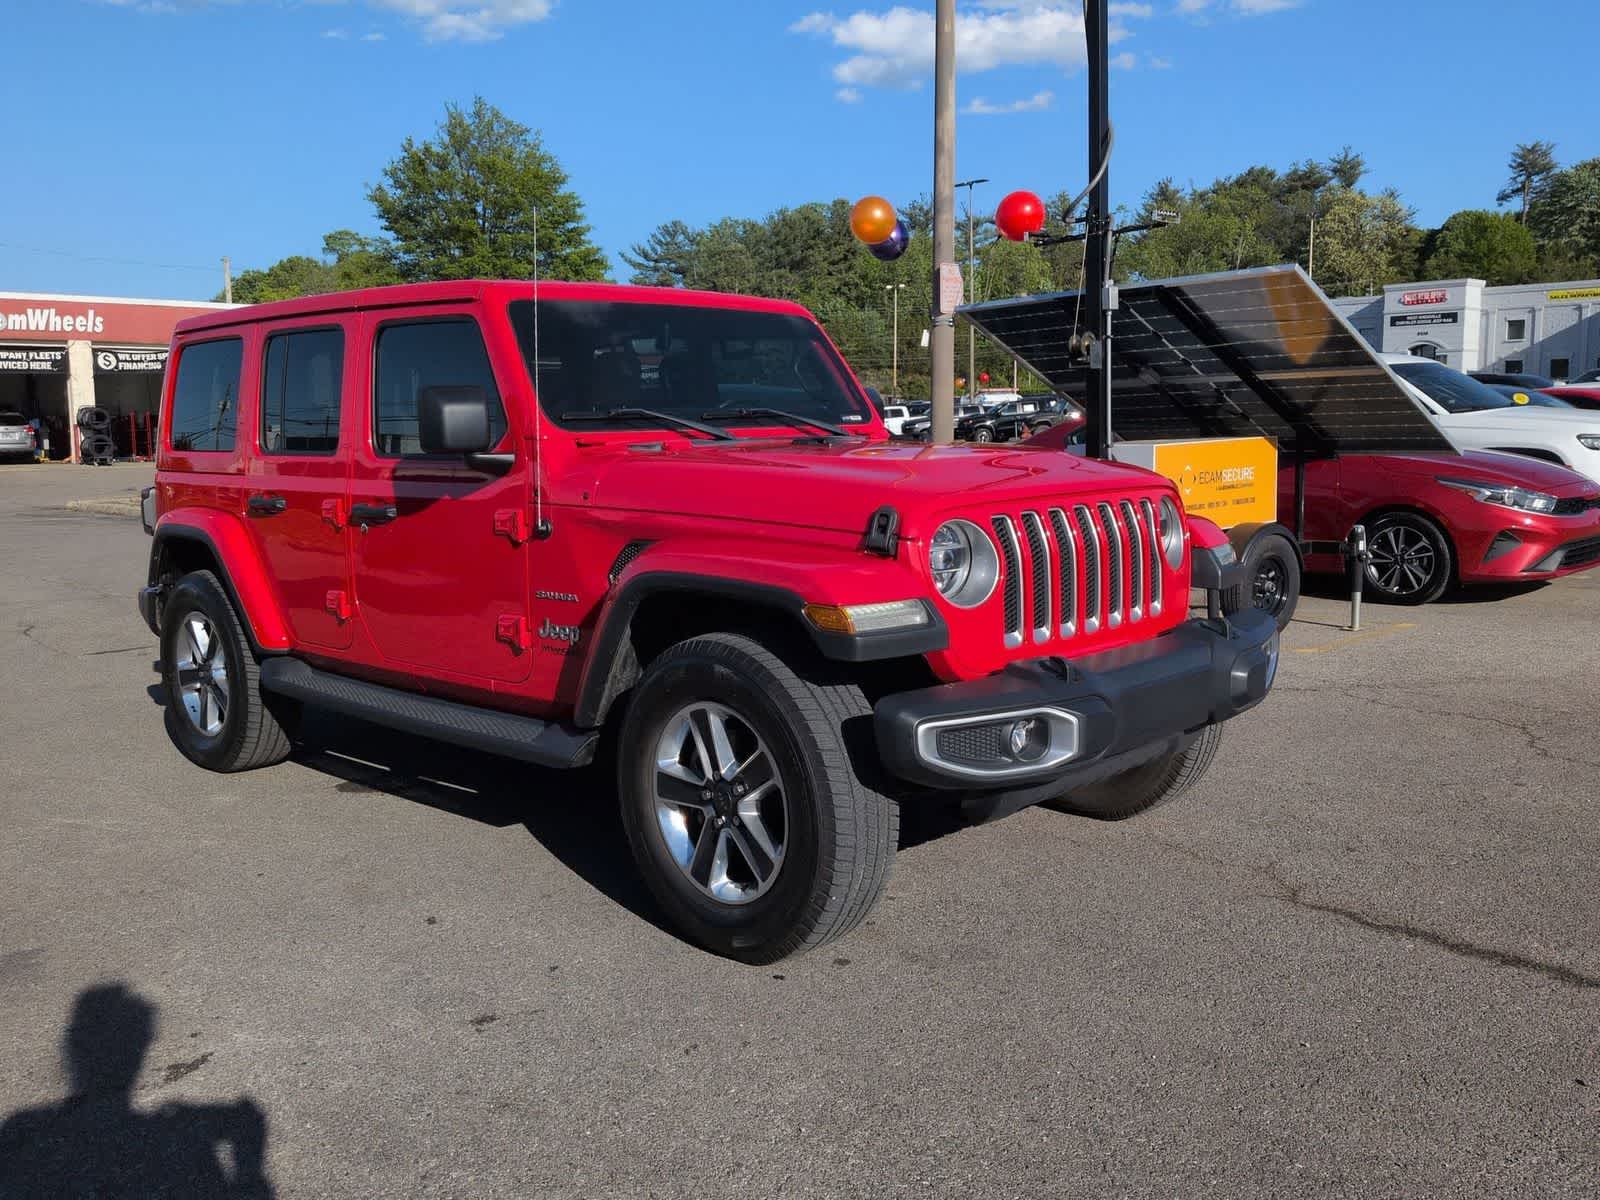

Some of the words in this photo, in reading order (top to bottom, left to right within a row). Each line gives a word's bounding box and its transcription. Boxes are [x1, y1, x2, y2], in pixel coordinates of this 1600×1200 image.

[29, 351, 62, 360] FLEETS
[30, 361, 52, 370] HERE
[118, 361, 162, 370] FINANCING
[536, 590, 579, 602] SAHARA
[539, 617, 579, 646] Jeep
